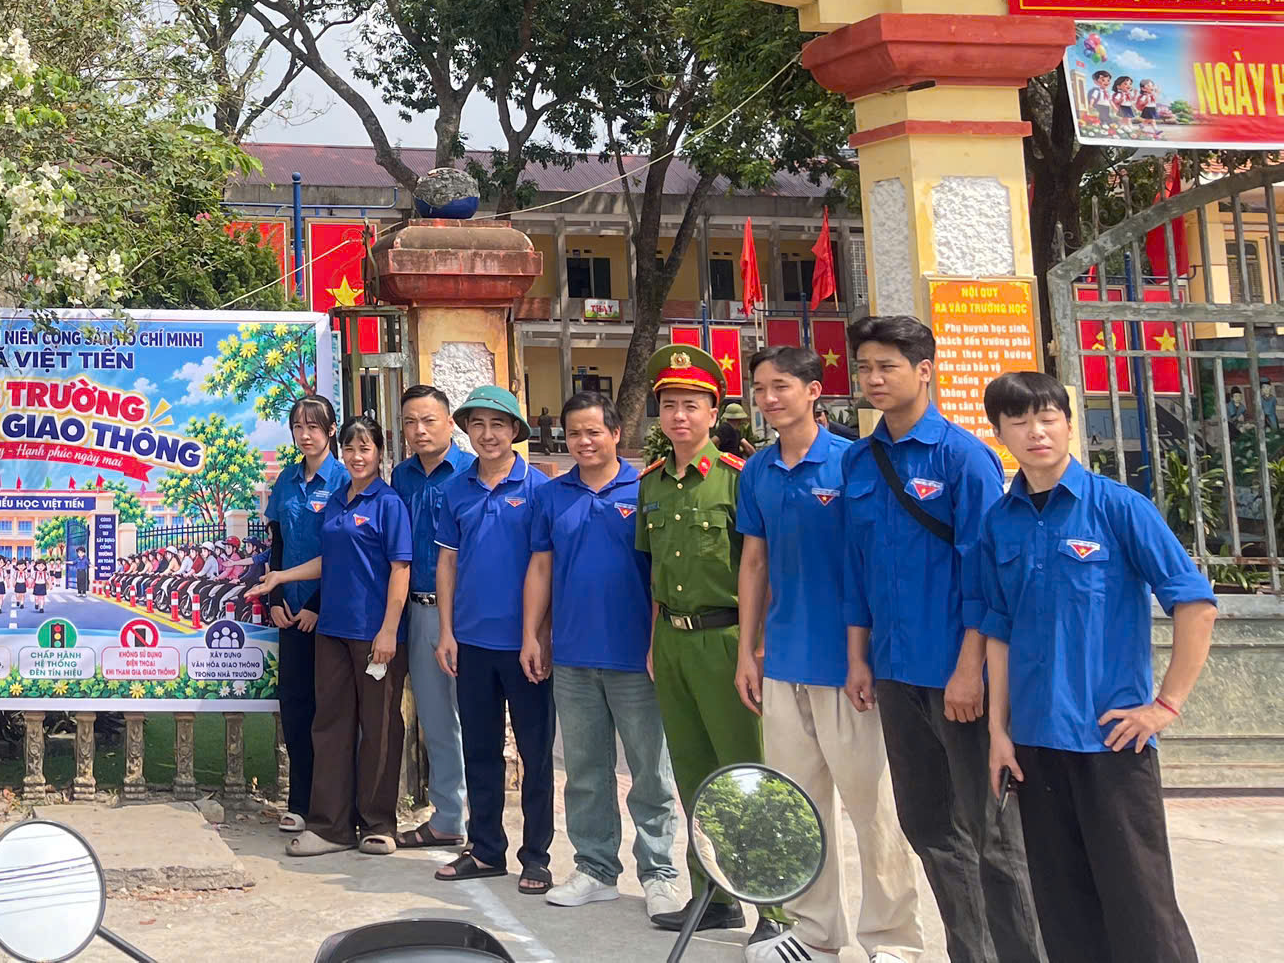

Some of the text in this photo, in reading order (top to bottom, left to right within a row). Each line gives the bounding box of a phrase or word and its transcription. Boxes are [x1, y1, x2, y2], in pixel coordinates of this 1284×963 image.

[1193, 51, 1267, 116] NGÀY
[980, 287, 998, 298] QUY
[963, 324, 989, 334] huynh
[991, 324, 1006, 334] học
[4, 327, 38, 346] NIÊN
[139, 329, 162, 347] CHÍ
[166, 332, 203, 347] MINH
[14, 348, 72, 373] VIỆT
[78, 345, 134, 370] TIẾN
[6, 378, 145, 422] TRƯỜNG
[2, 413, 86, 443] GIAO
[91, 422, 202, 468] THÔNG
[16, 444, 45, 458] Hạnh
[47, 446, 73, 461] phúc
[74, 450, 101, 466] ngày
[102, 455, 123, 467] mai
[16, 499, 39, 510] HỌC
[42, 498, 62, 510] VIỆT
[64, 497, 85, 509] TIẾN
[30, 649, 82, 659] CHẤP HÀNH
[119, 650, 138, 658] KHÔNG
[210, 650, 242, 659] XÂY DỰNG
[34, 658, 77, 669] HỆ THỐNG
[191, 660, 204, 668] VĂN
[206, 660, 220, 668] HÓA
[239, 660, 260, 668] THÔNG
[29, 668, 82, 677] ĐÈN TÍN HIỆU
[217, 669, 231, 678] NHÀ
[232, 669, 257, 678] TRƯỜNG
